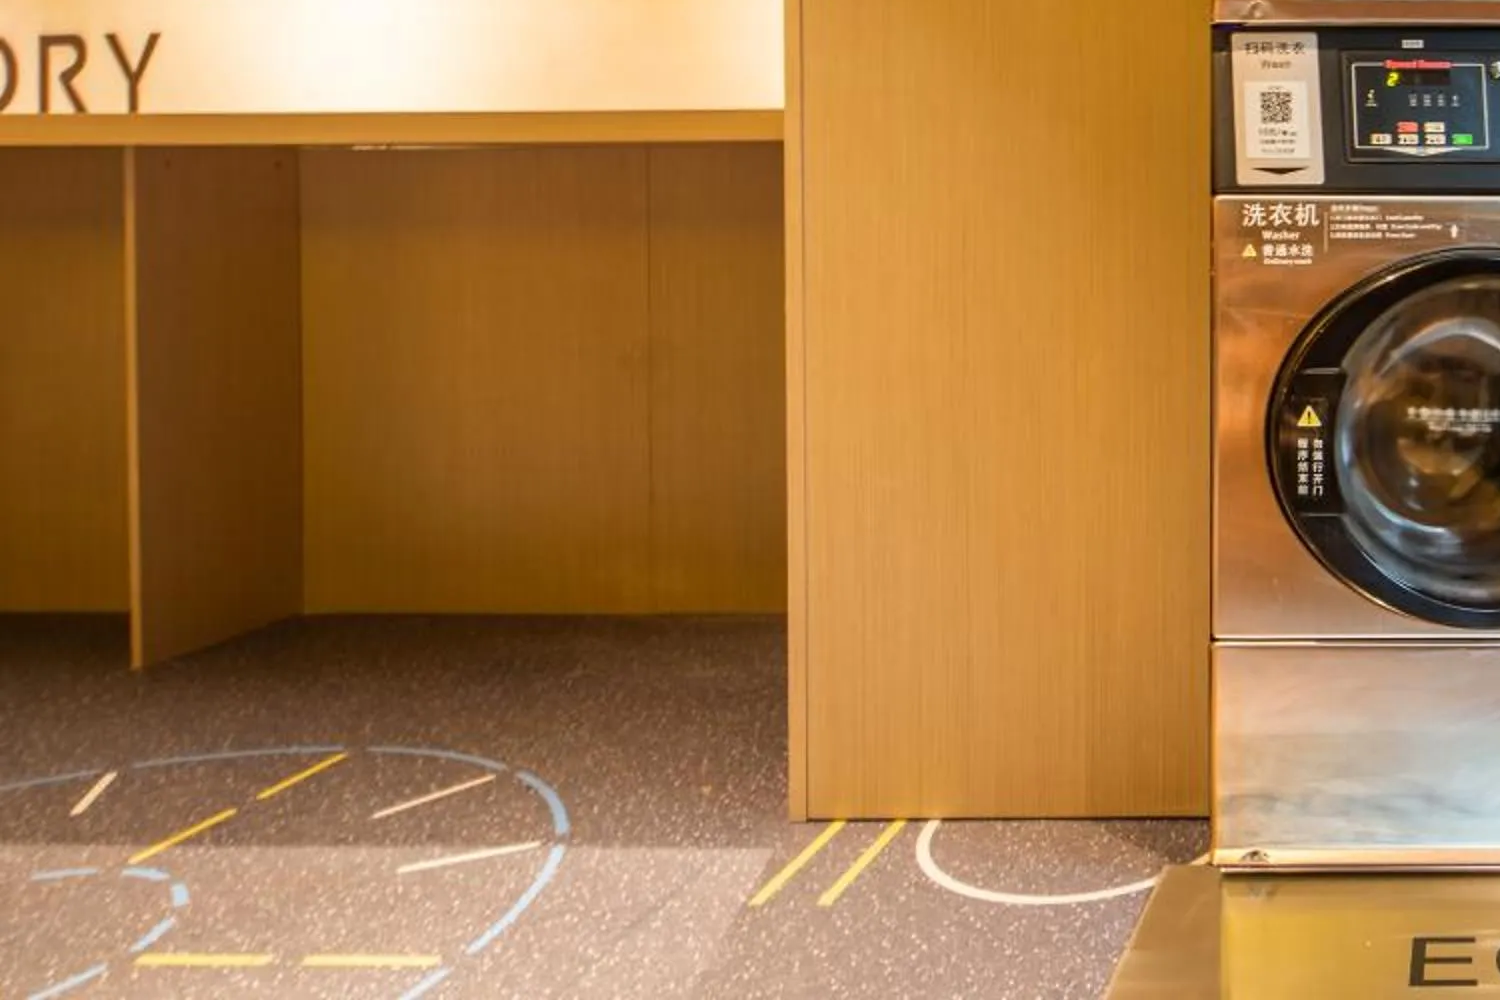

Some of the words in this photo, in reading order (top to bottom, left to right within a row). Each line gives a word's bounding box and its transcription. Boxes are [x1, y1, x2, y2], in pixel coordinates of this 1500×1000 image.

[1242, 203, 1320, 227] 洗衣机
[1262, 229, 1300, 241] Washer
[1262, 244, 1314, 257] 普通水洗
